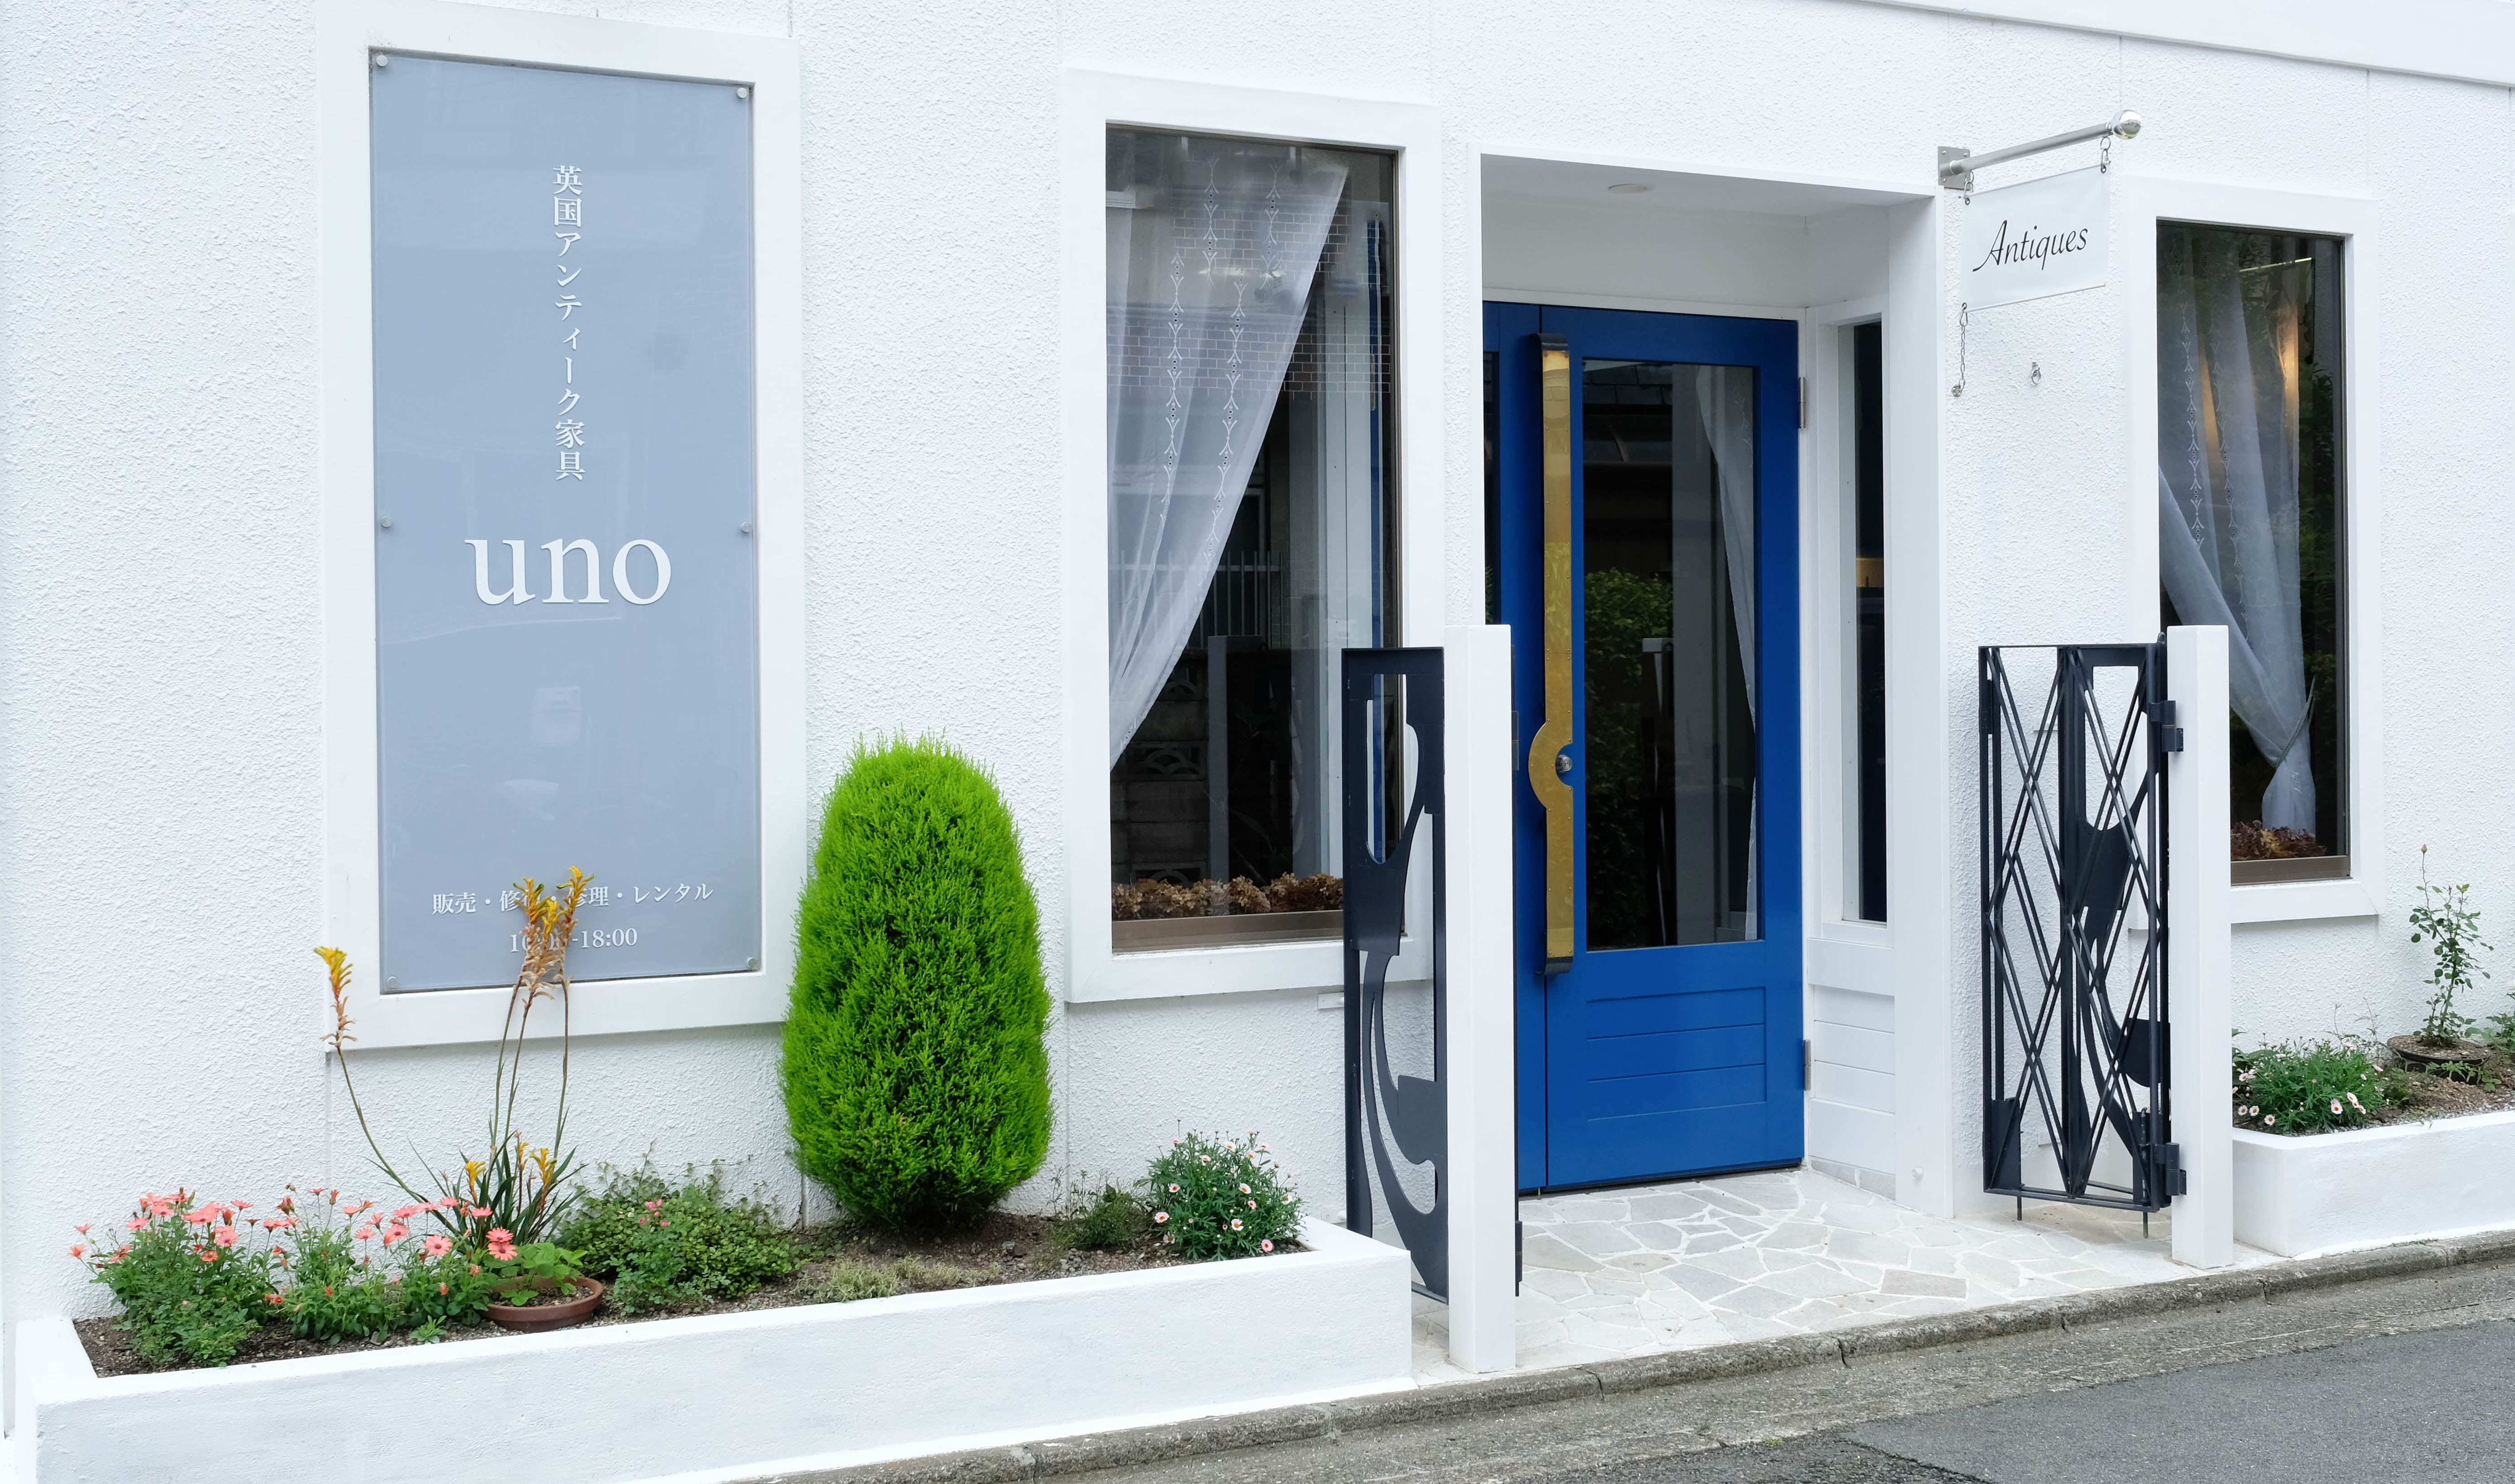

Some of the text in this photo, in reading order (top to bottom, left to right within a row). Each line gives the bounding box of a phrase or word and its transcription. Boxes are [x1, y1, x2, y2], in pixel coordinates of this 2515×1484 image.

[1972, 220, 2088, 272] Antiques
[553, 165, 586, 480] 英国アンティーク家具
[464, 538, 672, 605] uno
